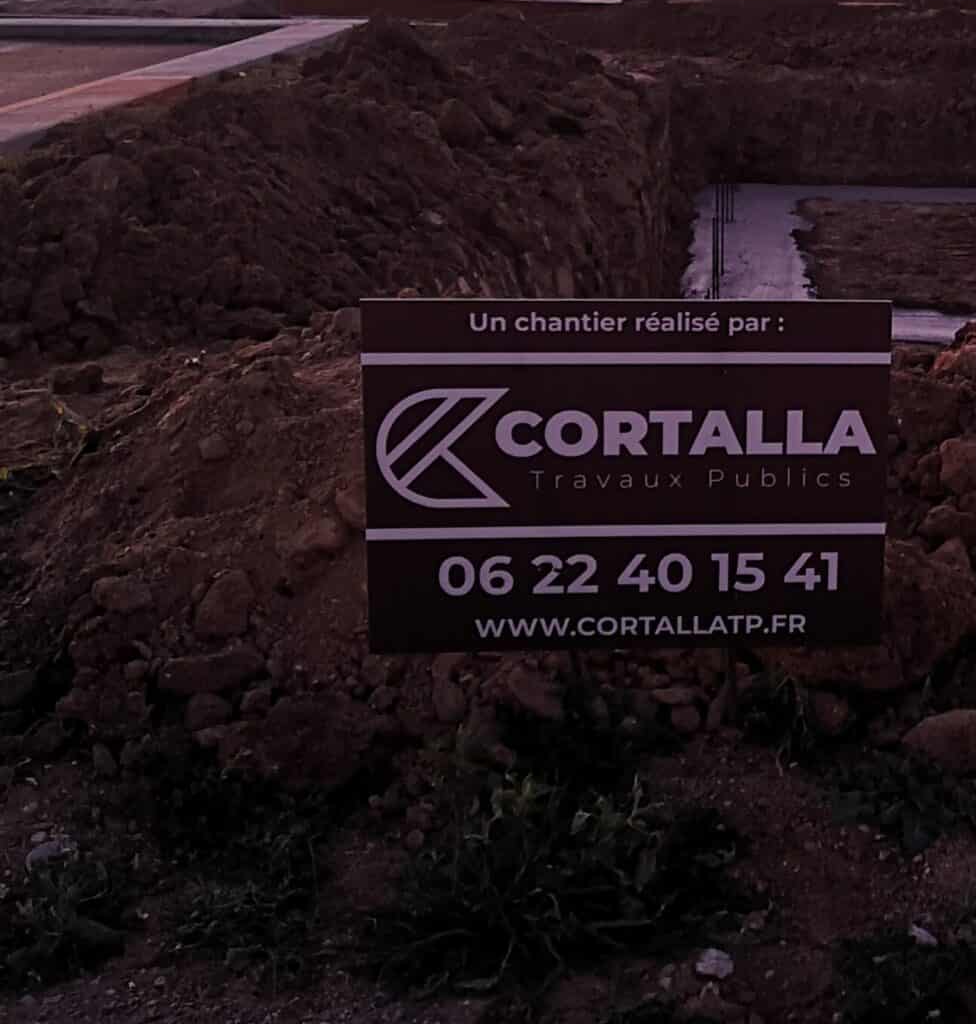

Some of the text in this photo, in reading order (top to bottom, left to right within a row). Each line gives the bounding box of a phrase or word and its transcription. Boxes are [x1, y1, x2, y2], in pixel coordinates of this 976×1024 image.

[469, 312, 507, 332] Un
[514, 311, 628, 332] chantier
[635, 311, 720, 332] réalisé
[728, 316, 771, 337] par
[495, 409, 877, 458] CORTALLA
[530, 468, 852, 489] Travaux Publics
[438, 551, 839, 596] 06 22 40 15 41
[475, 614, 807, 638] WWW.CORTALLATP.FR
